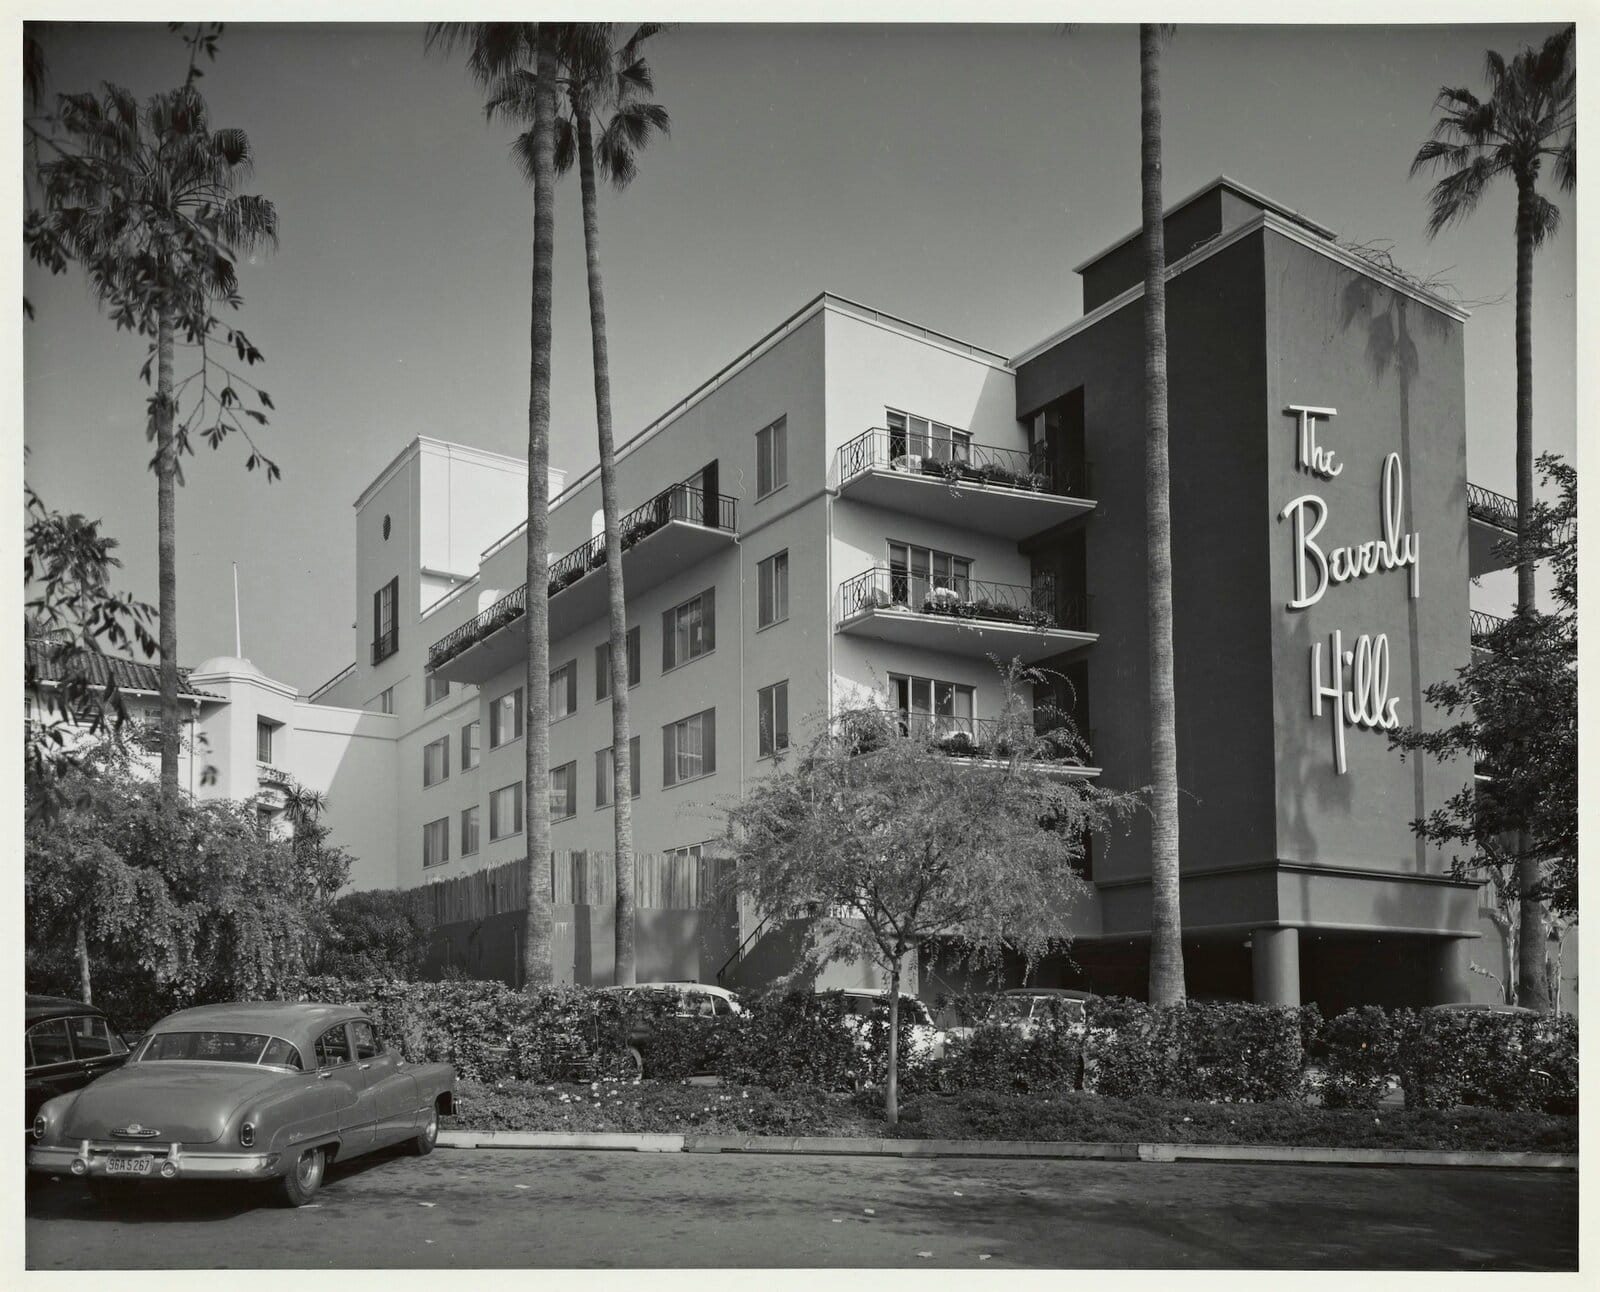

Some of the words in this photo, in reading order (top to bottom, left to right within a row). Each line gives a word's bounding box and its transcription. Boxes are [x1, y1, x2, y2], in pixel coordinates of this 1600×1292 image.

[1288, 404, 1344, 476] The
[1282, 451, 1420, 608] Beverly
[1311, 628, 1400, 774] Hills
